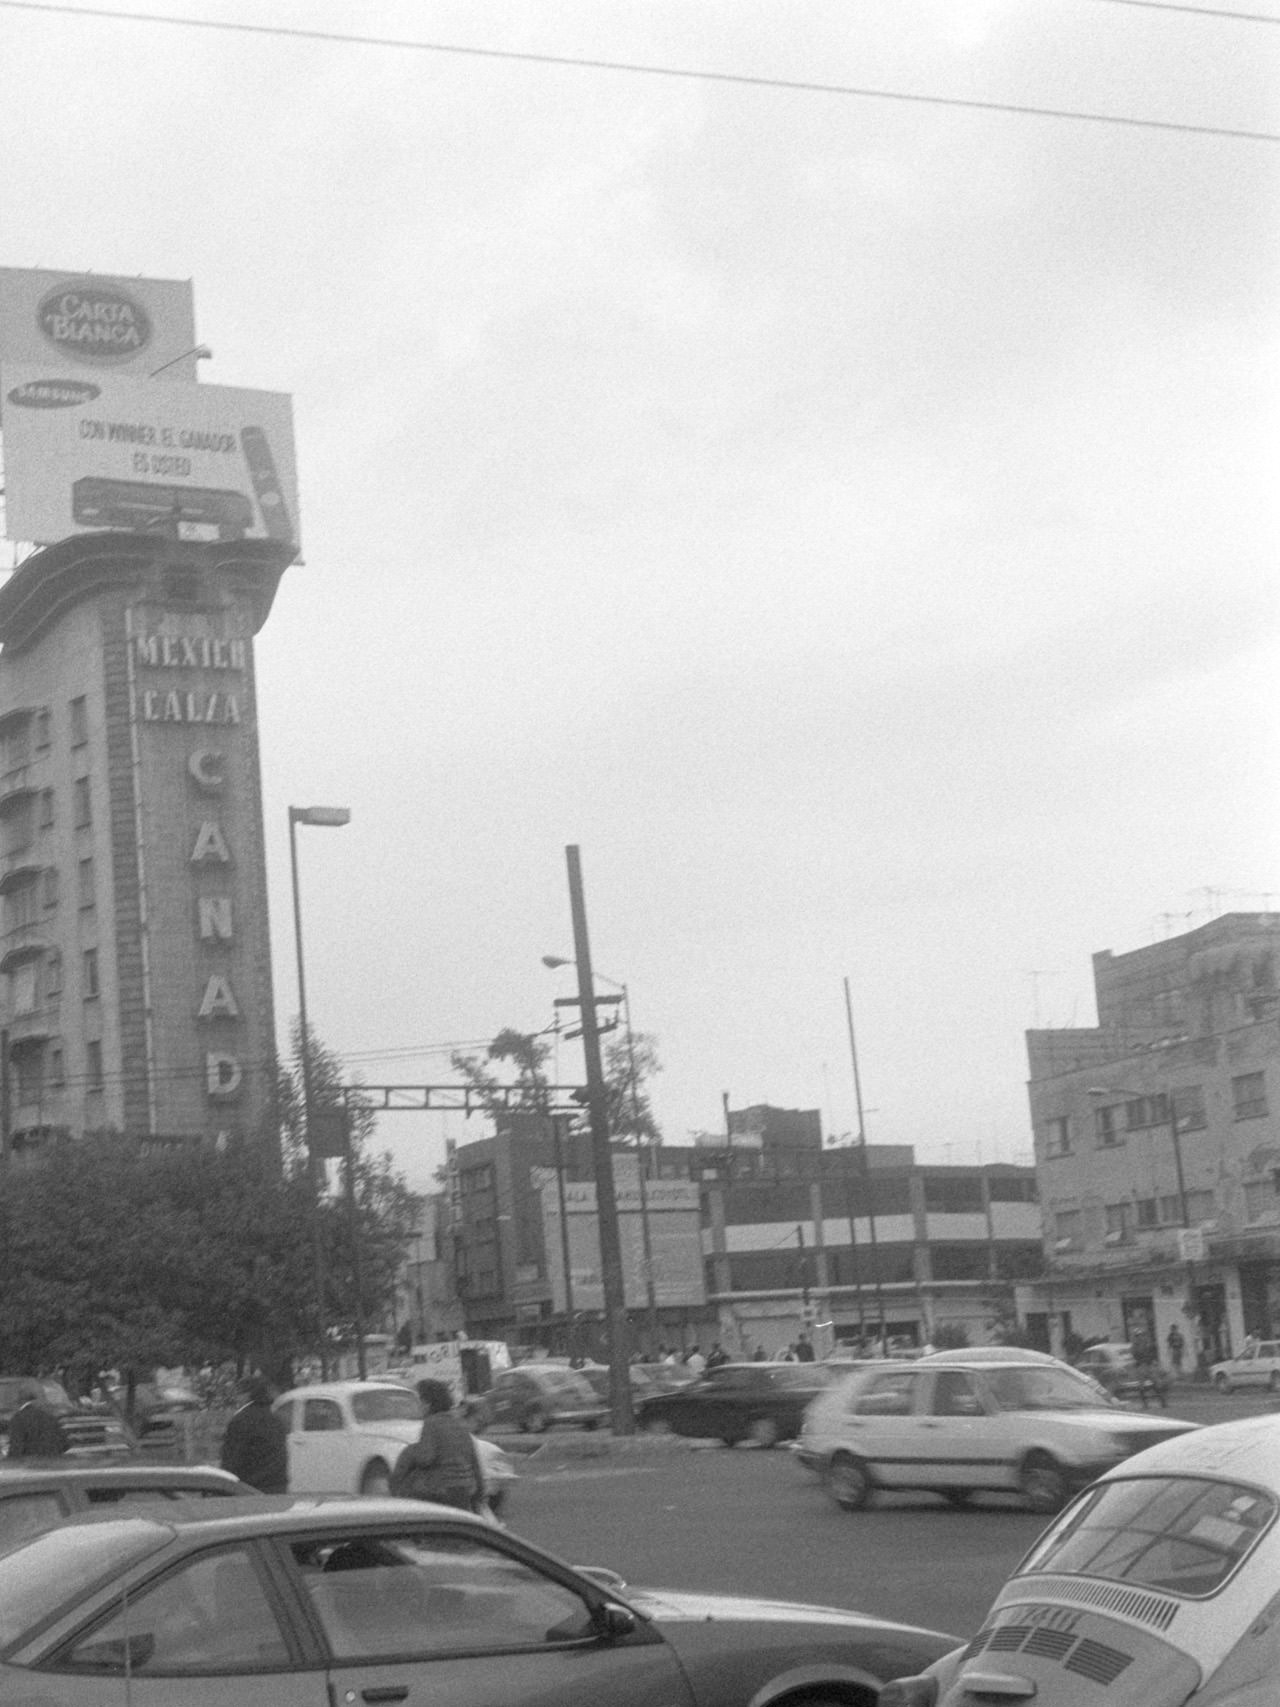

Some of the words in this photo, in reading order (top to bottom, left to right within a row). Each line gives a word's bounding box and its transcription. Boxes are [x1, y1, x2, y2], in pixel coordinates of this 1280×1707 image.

[60, 294, 135, 322] CARTA
[47, 315, 141, 345] BLANCA
[188, 750, 243, 1152] CANAD
